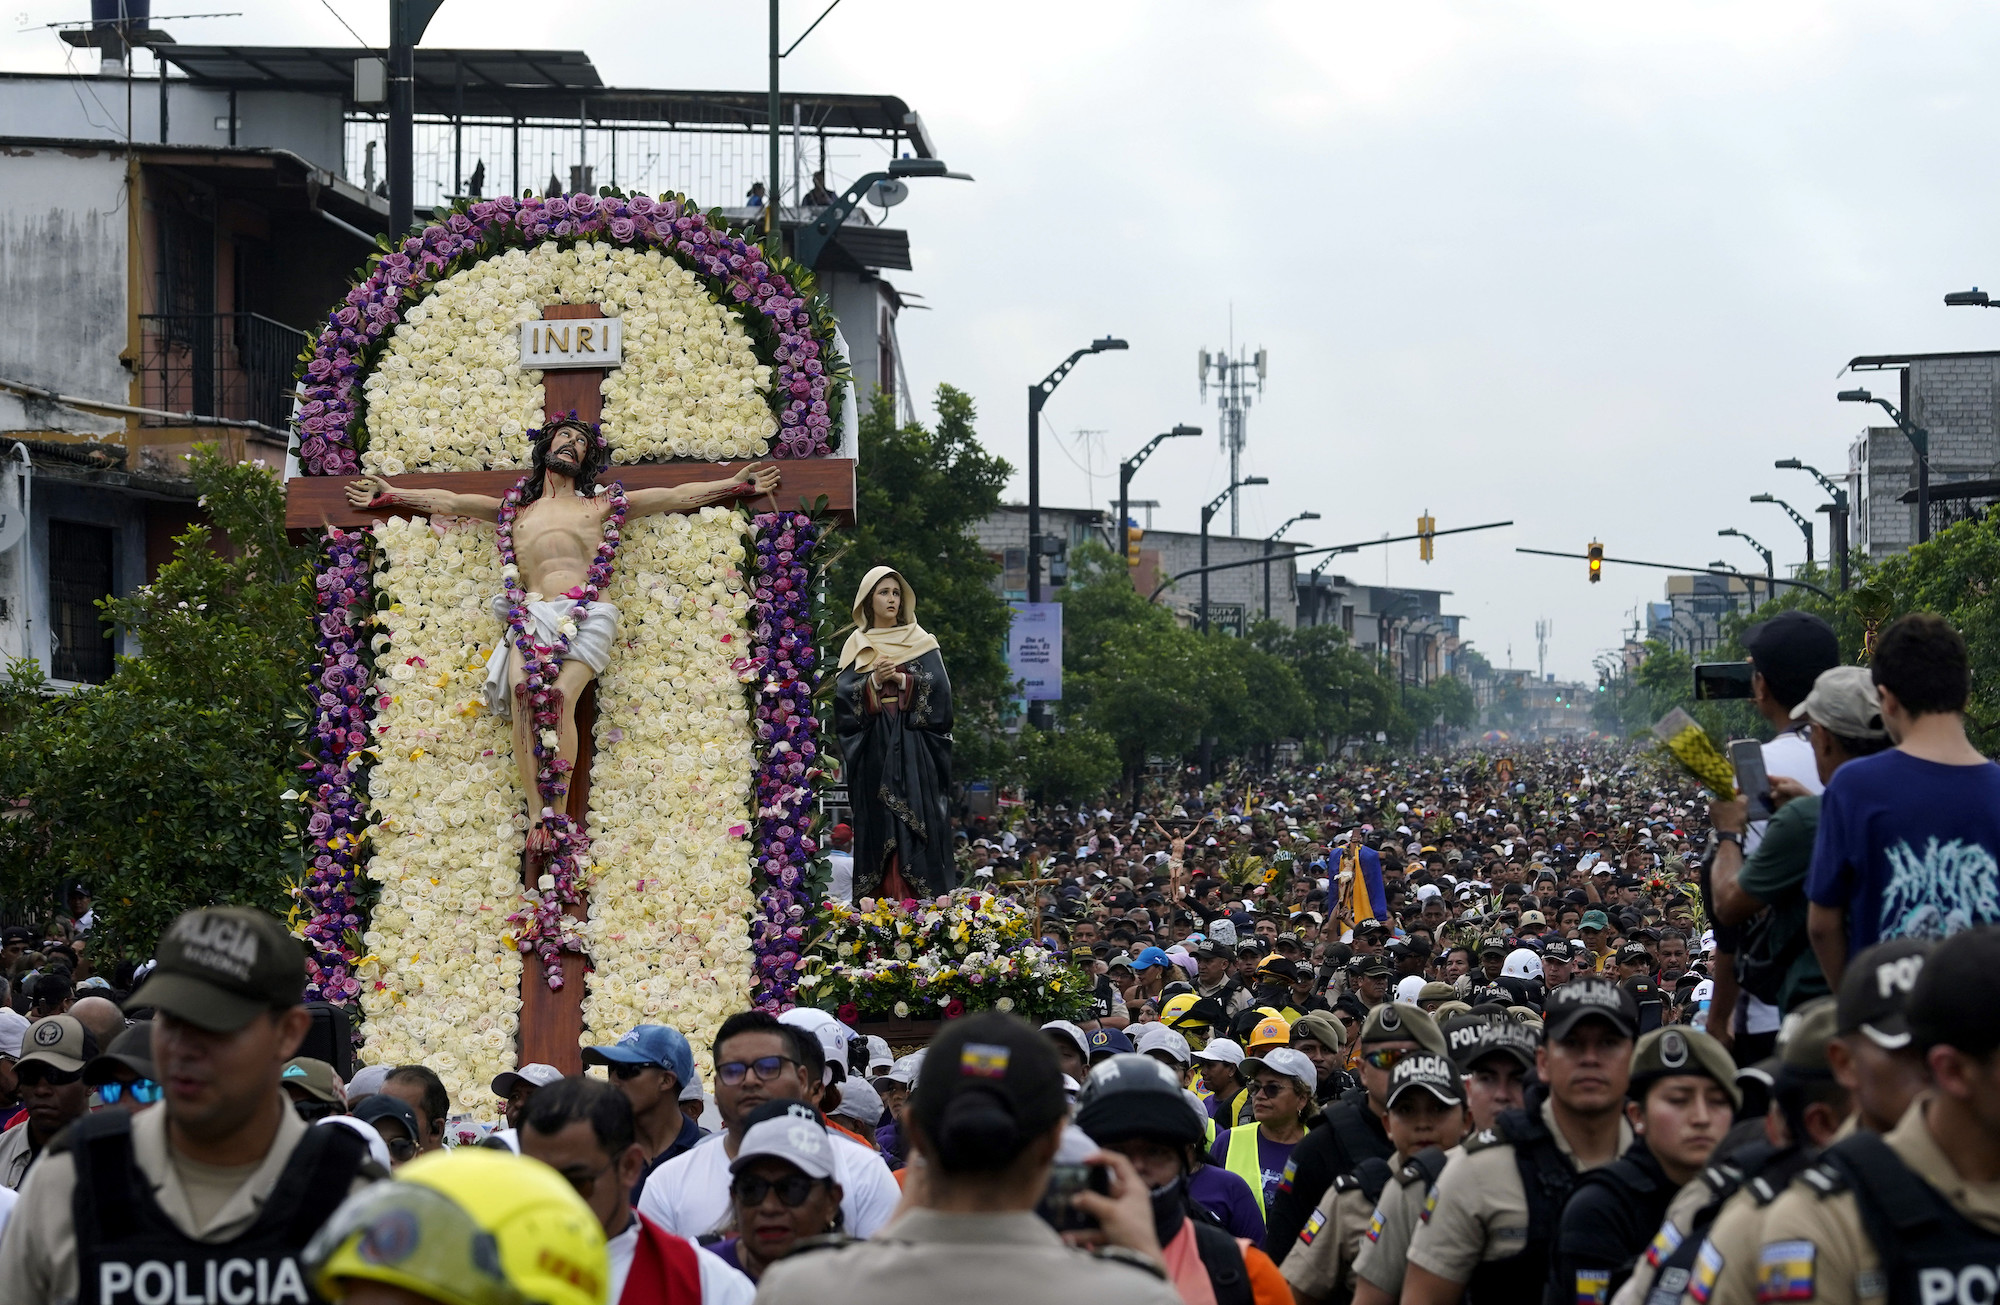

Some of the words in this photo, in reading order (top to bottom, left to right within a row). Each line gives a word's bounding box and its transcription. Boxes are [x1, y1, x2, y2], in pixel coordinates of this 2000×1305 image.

[532, 325, 609, 354] INRI
[1020, 656, 1050, 664] contigo
[1558, 980, 1622, 1007] POLICÍA
[1393, 1055, 1451, 1084] POLICÍA
[1410, 1074, 1451, 1088] NACIONAL
[99, 1256, 309, 1305] POLICIA
